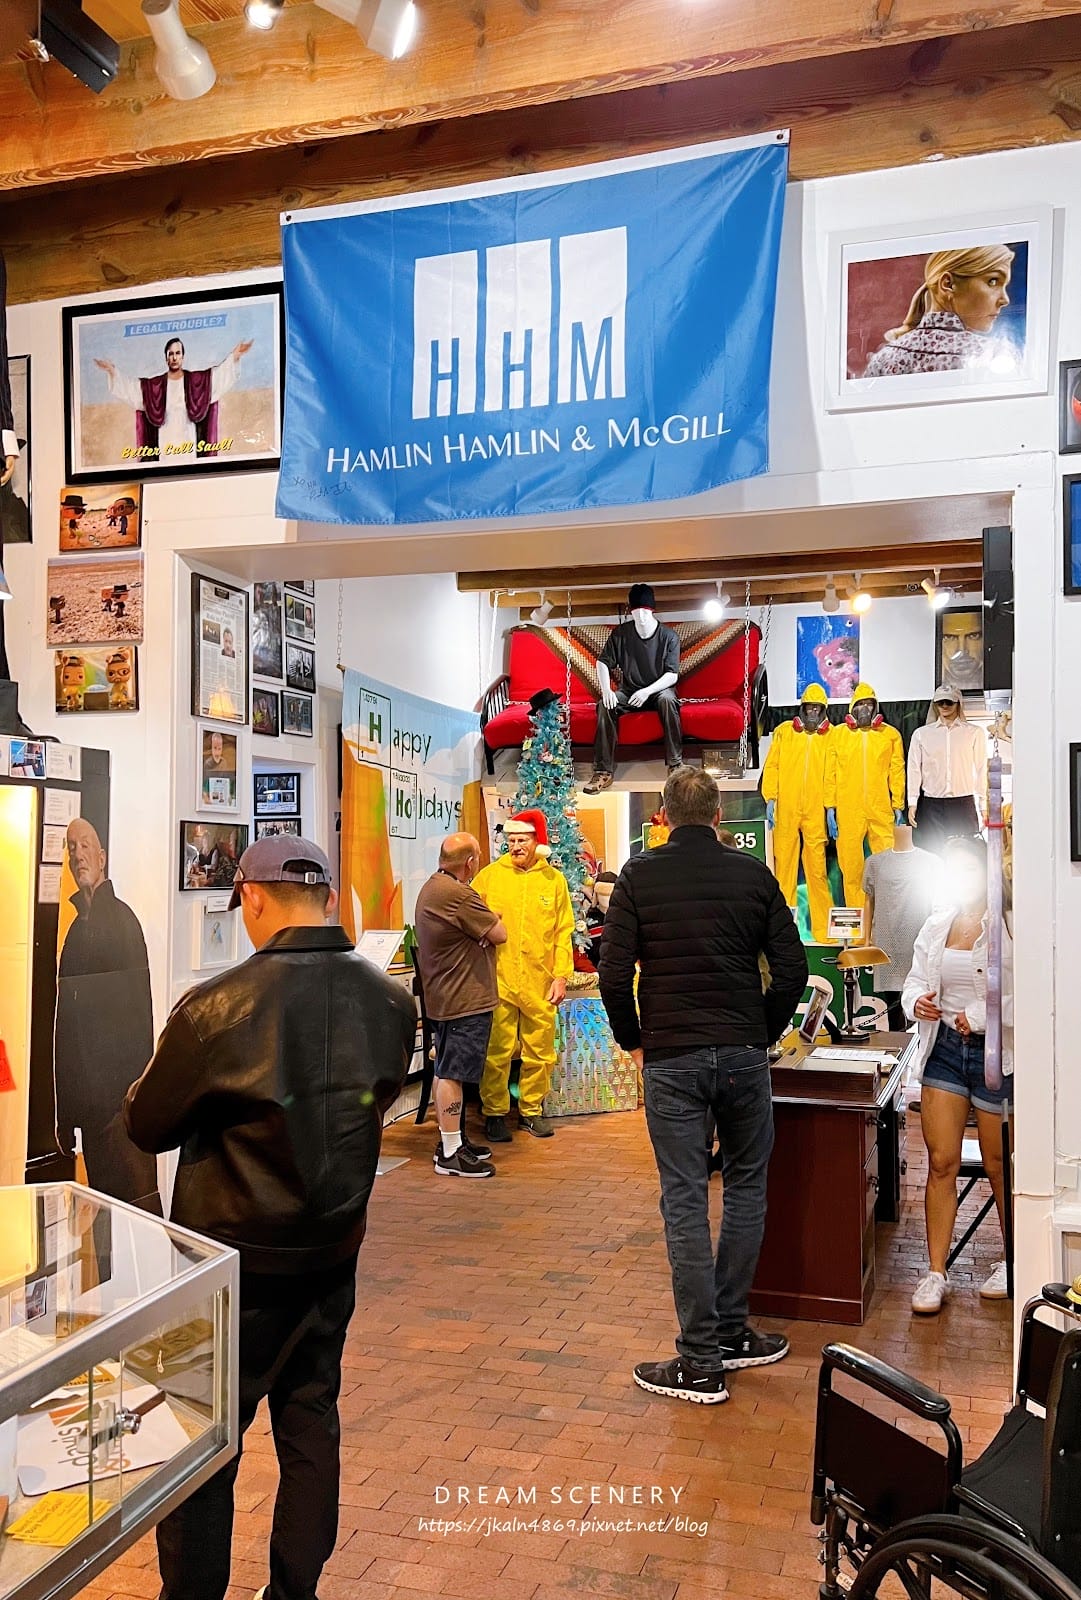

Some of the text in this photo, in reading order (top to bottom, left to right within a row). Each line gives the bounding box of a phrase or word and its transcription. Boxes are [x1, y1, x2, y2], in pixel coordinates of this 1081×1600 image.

[130, 316, 223, 335] LEGAL TROUBLE?
[121, 437, 234, 460] Better Call Saul!
[326, 440, 432, 473] HAMLIN
[443, 426, 561, 464] HAMLIN
[571, 424, 596, 452] &
[735, 832, 757, 849] 35
